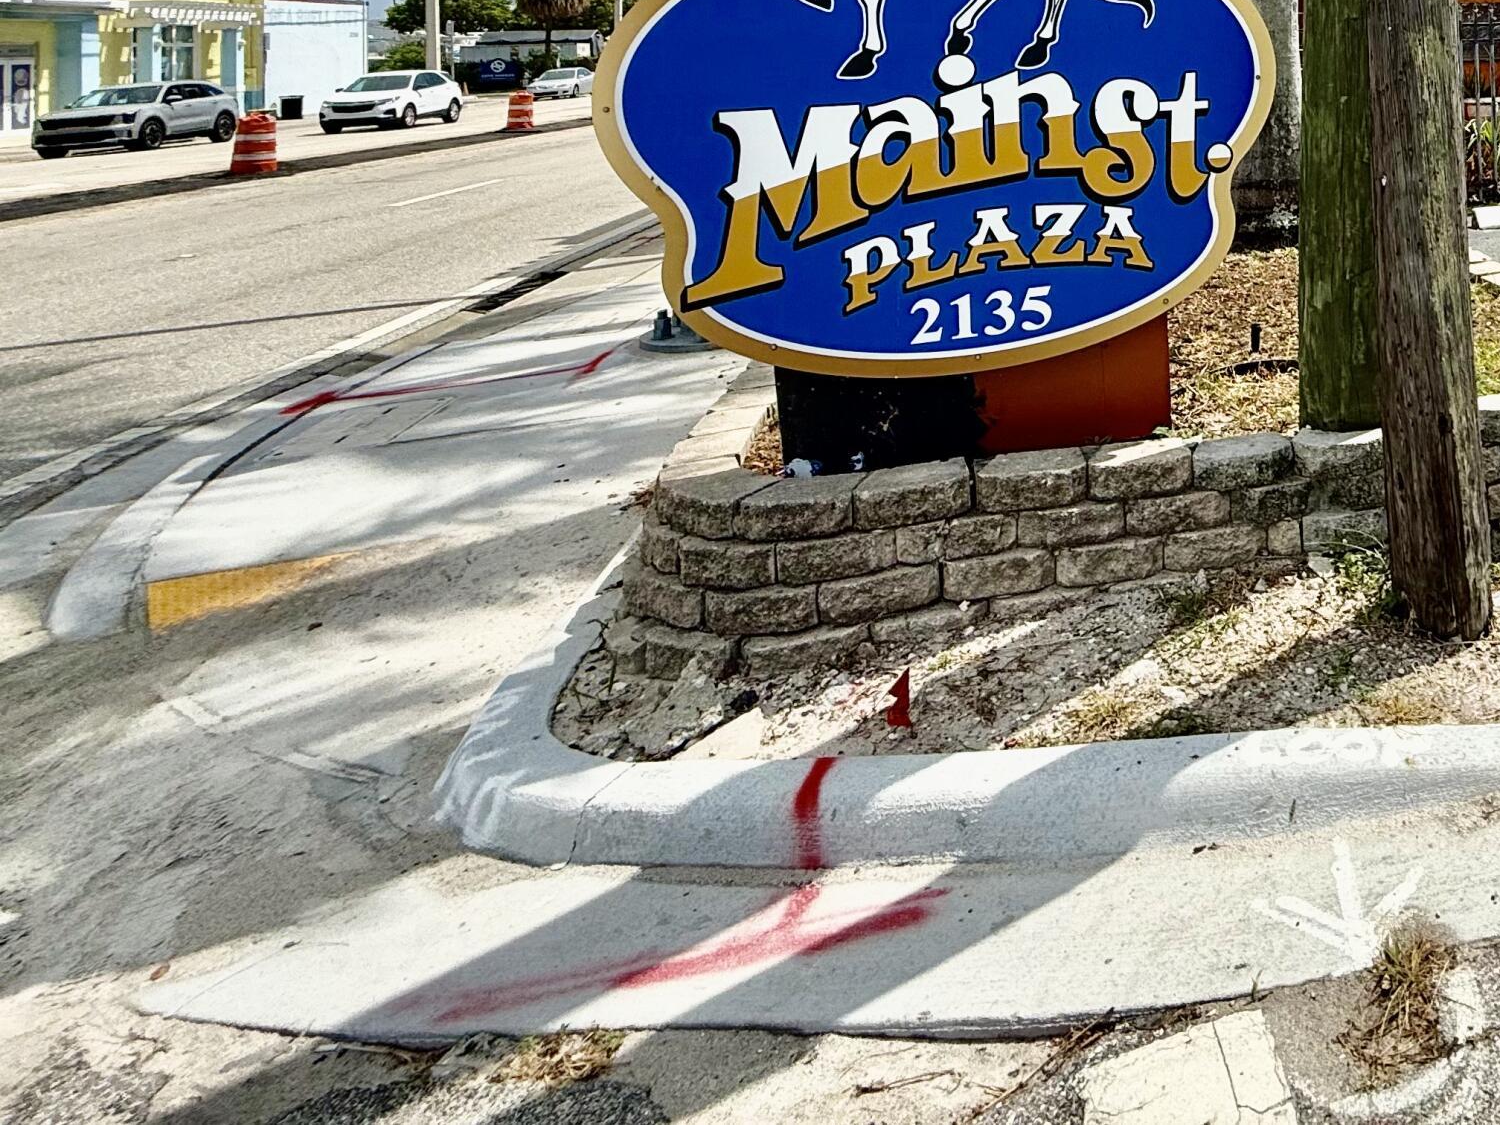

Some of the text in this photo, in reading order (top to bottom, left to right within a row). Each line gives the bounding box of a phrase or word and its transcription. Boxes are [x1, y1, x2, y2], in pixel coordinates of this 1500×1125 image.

[682, 54, 1088, 312] Main
[842, 202, 1154, 315] PLAZA
[909, 284, 1054, 346] 2135
